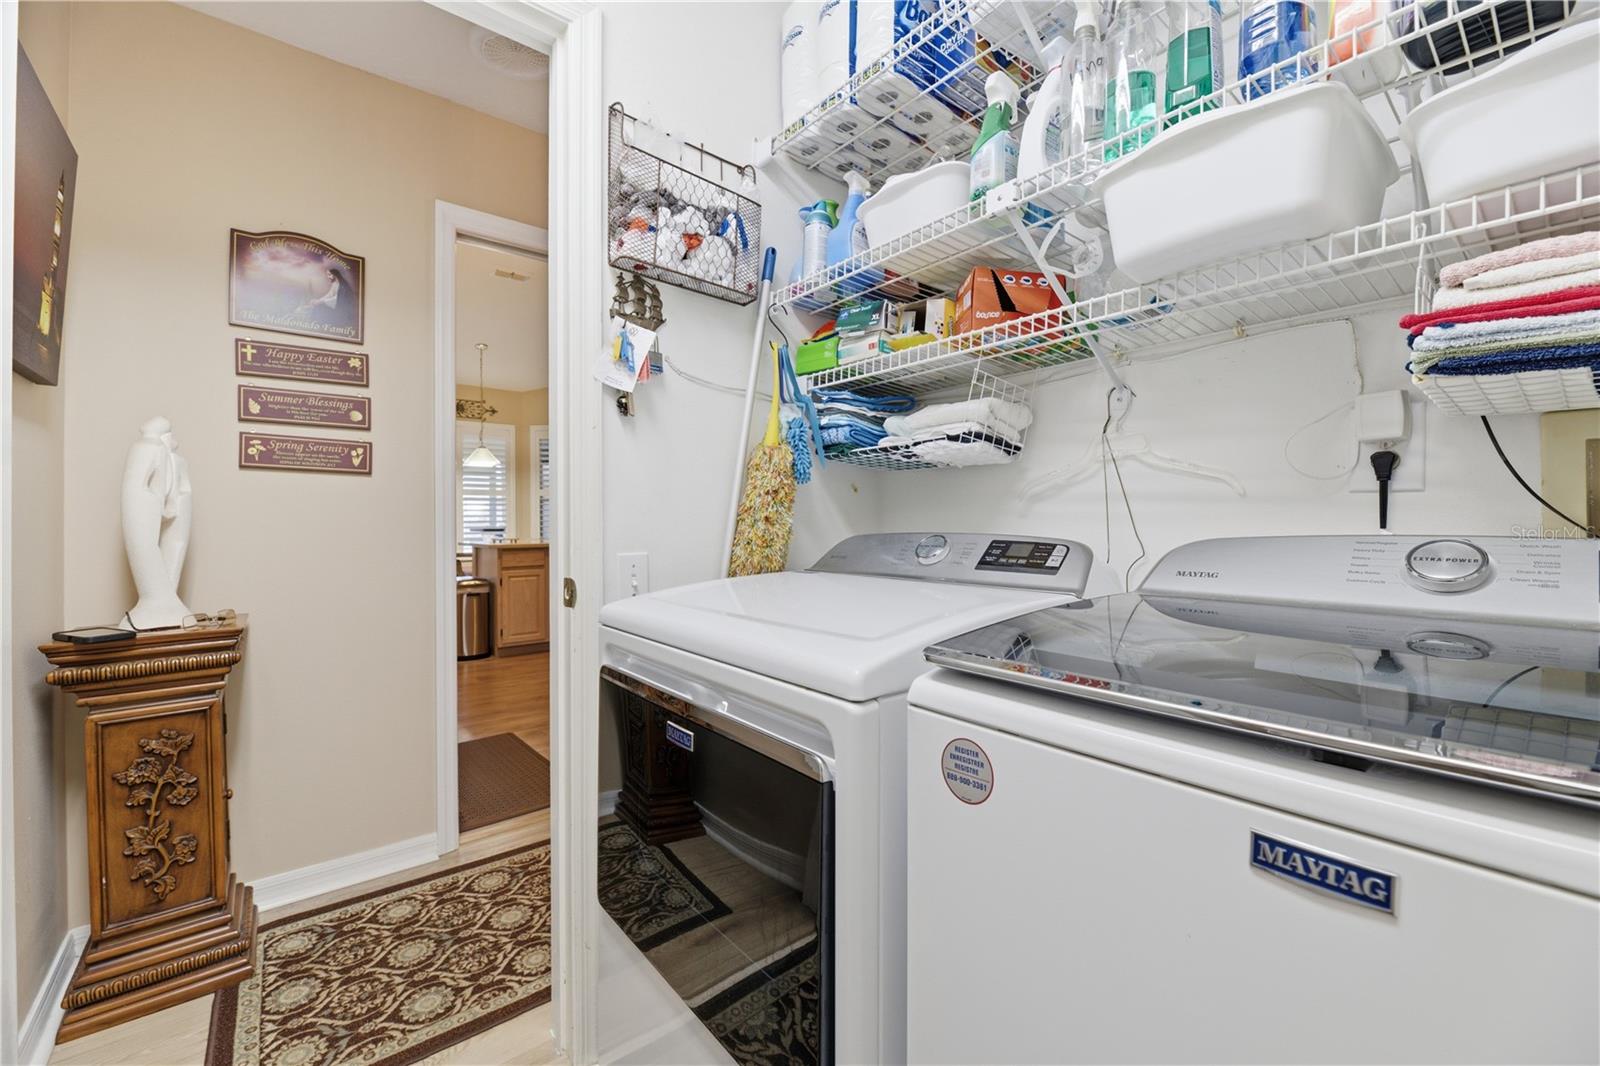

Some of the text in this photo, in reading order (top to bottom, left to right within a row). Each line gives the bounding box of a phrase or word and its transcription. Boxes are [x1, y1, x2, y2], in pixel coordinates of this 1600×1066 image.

[303, 242, 323, 255] This
[241, 309, 356, 338] The Maldonado Family
[264, 347, 305, 363] Happy
[307, 352, 343, 365] Easter
[258, 391, 306, 406] Summer
[306, 396, 353, 412] Blessings
[266, 439, 305, 453] Spring
[305, 442, 349, 457] Serenity
[1175, 570, 1221, 579] MAYTAG
[954, 745, 979, 758] REGISTER
[1256, 839, 1389, 903] MAYTAG
